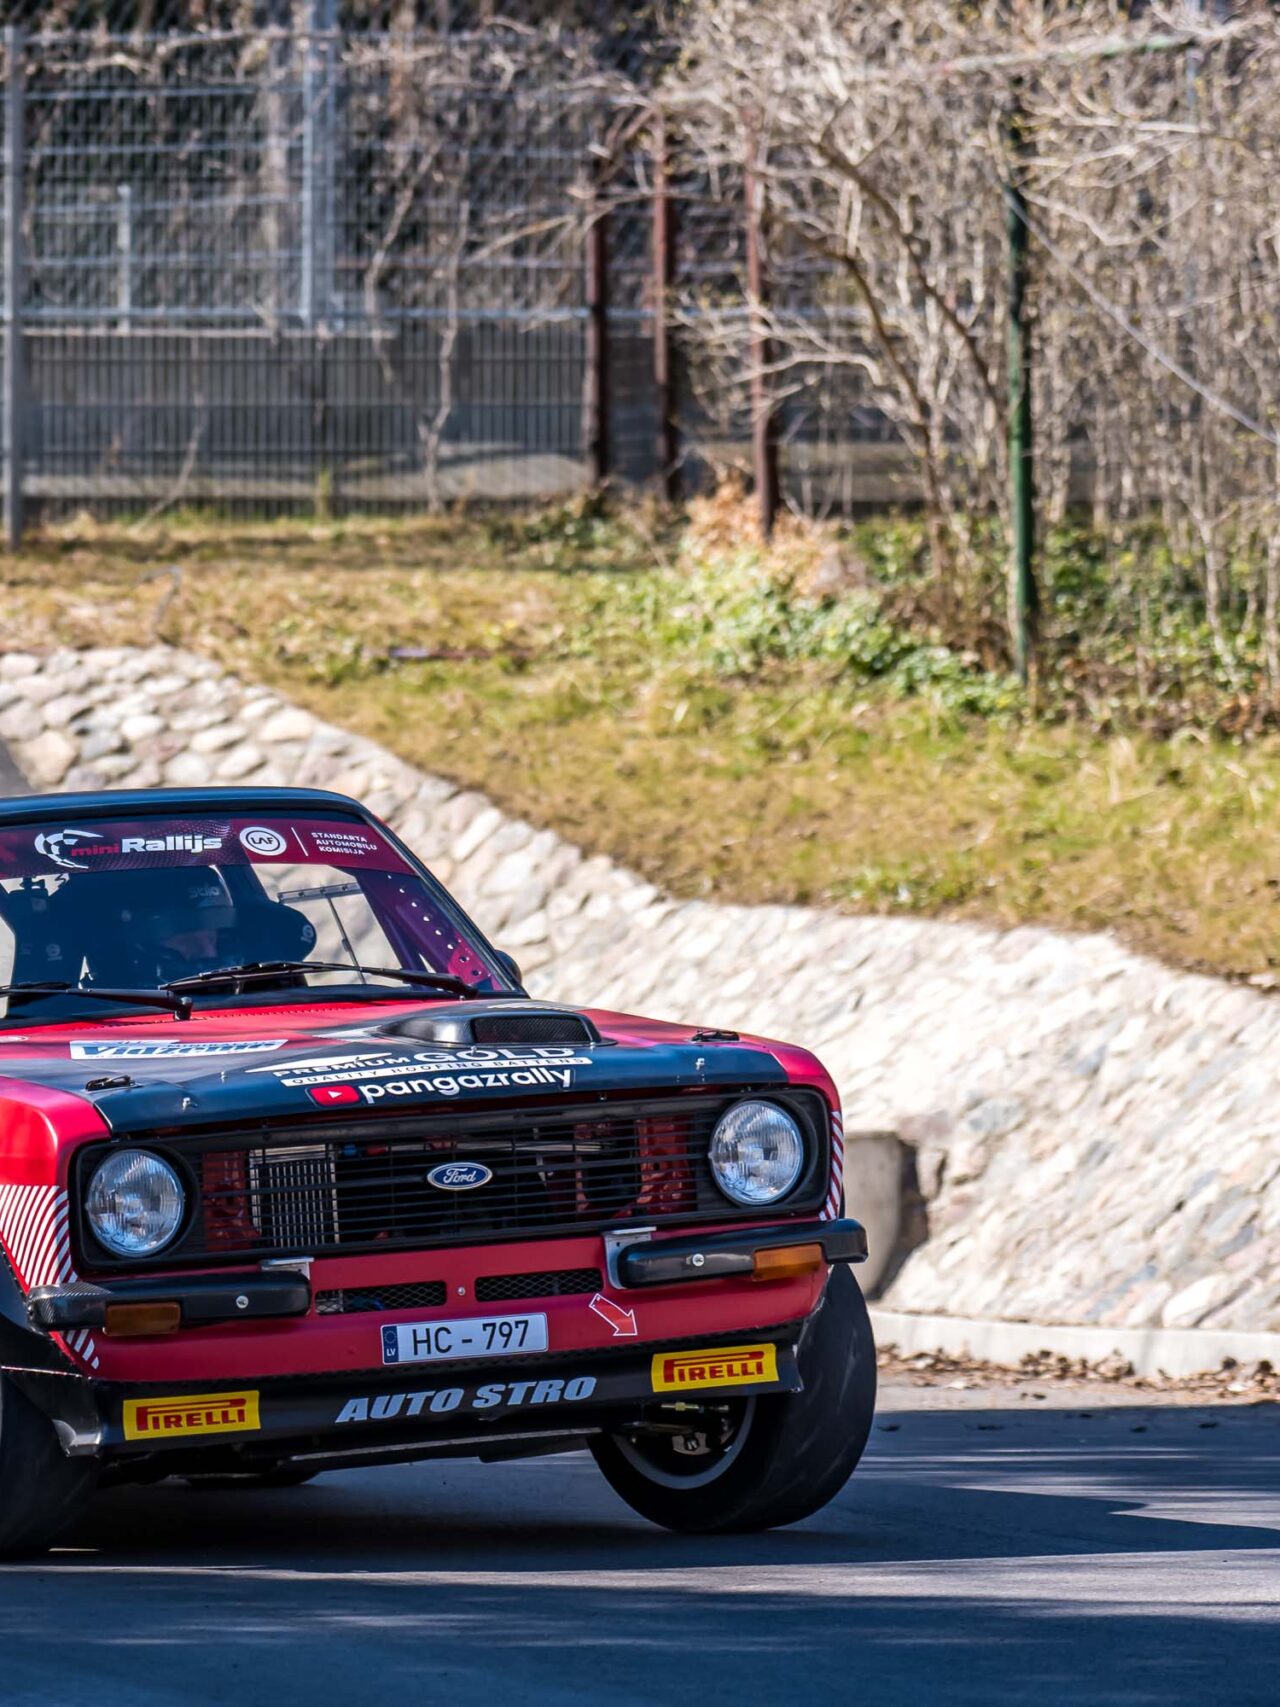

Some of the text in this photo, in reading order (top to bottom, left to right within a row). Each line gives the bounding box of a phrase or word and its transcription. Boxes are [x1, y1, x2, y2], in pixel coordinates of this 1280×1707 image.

[311, 832, 368, 843] STANDARTA
[318, 846, 365, 856] KOMISIJA
[273, 1047, 575, 1077] PREMIUM GOLD
[292, 1057, 584, 1085] QUALITY ROOFING BATTENS
[359, 1067, 571, 1105] pangazrally
[443, 1167, 477, 1184] Ford
[386, 1348, 396, 1356] LV
[663, 1350, 765, 1384] PIRELLI
[335, 1376, 597, 1423] AUTO STRO
[135, 1398, 247, 1432] PIRELLI
